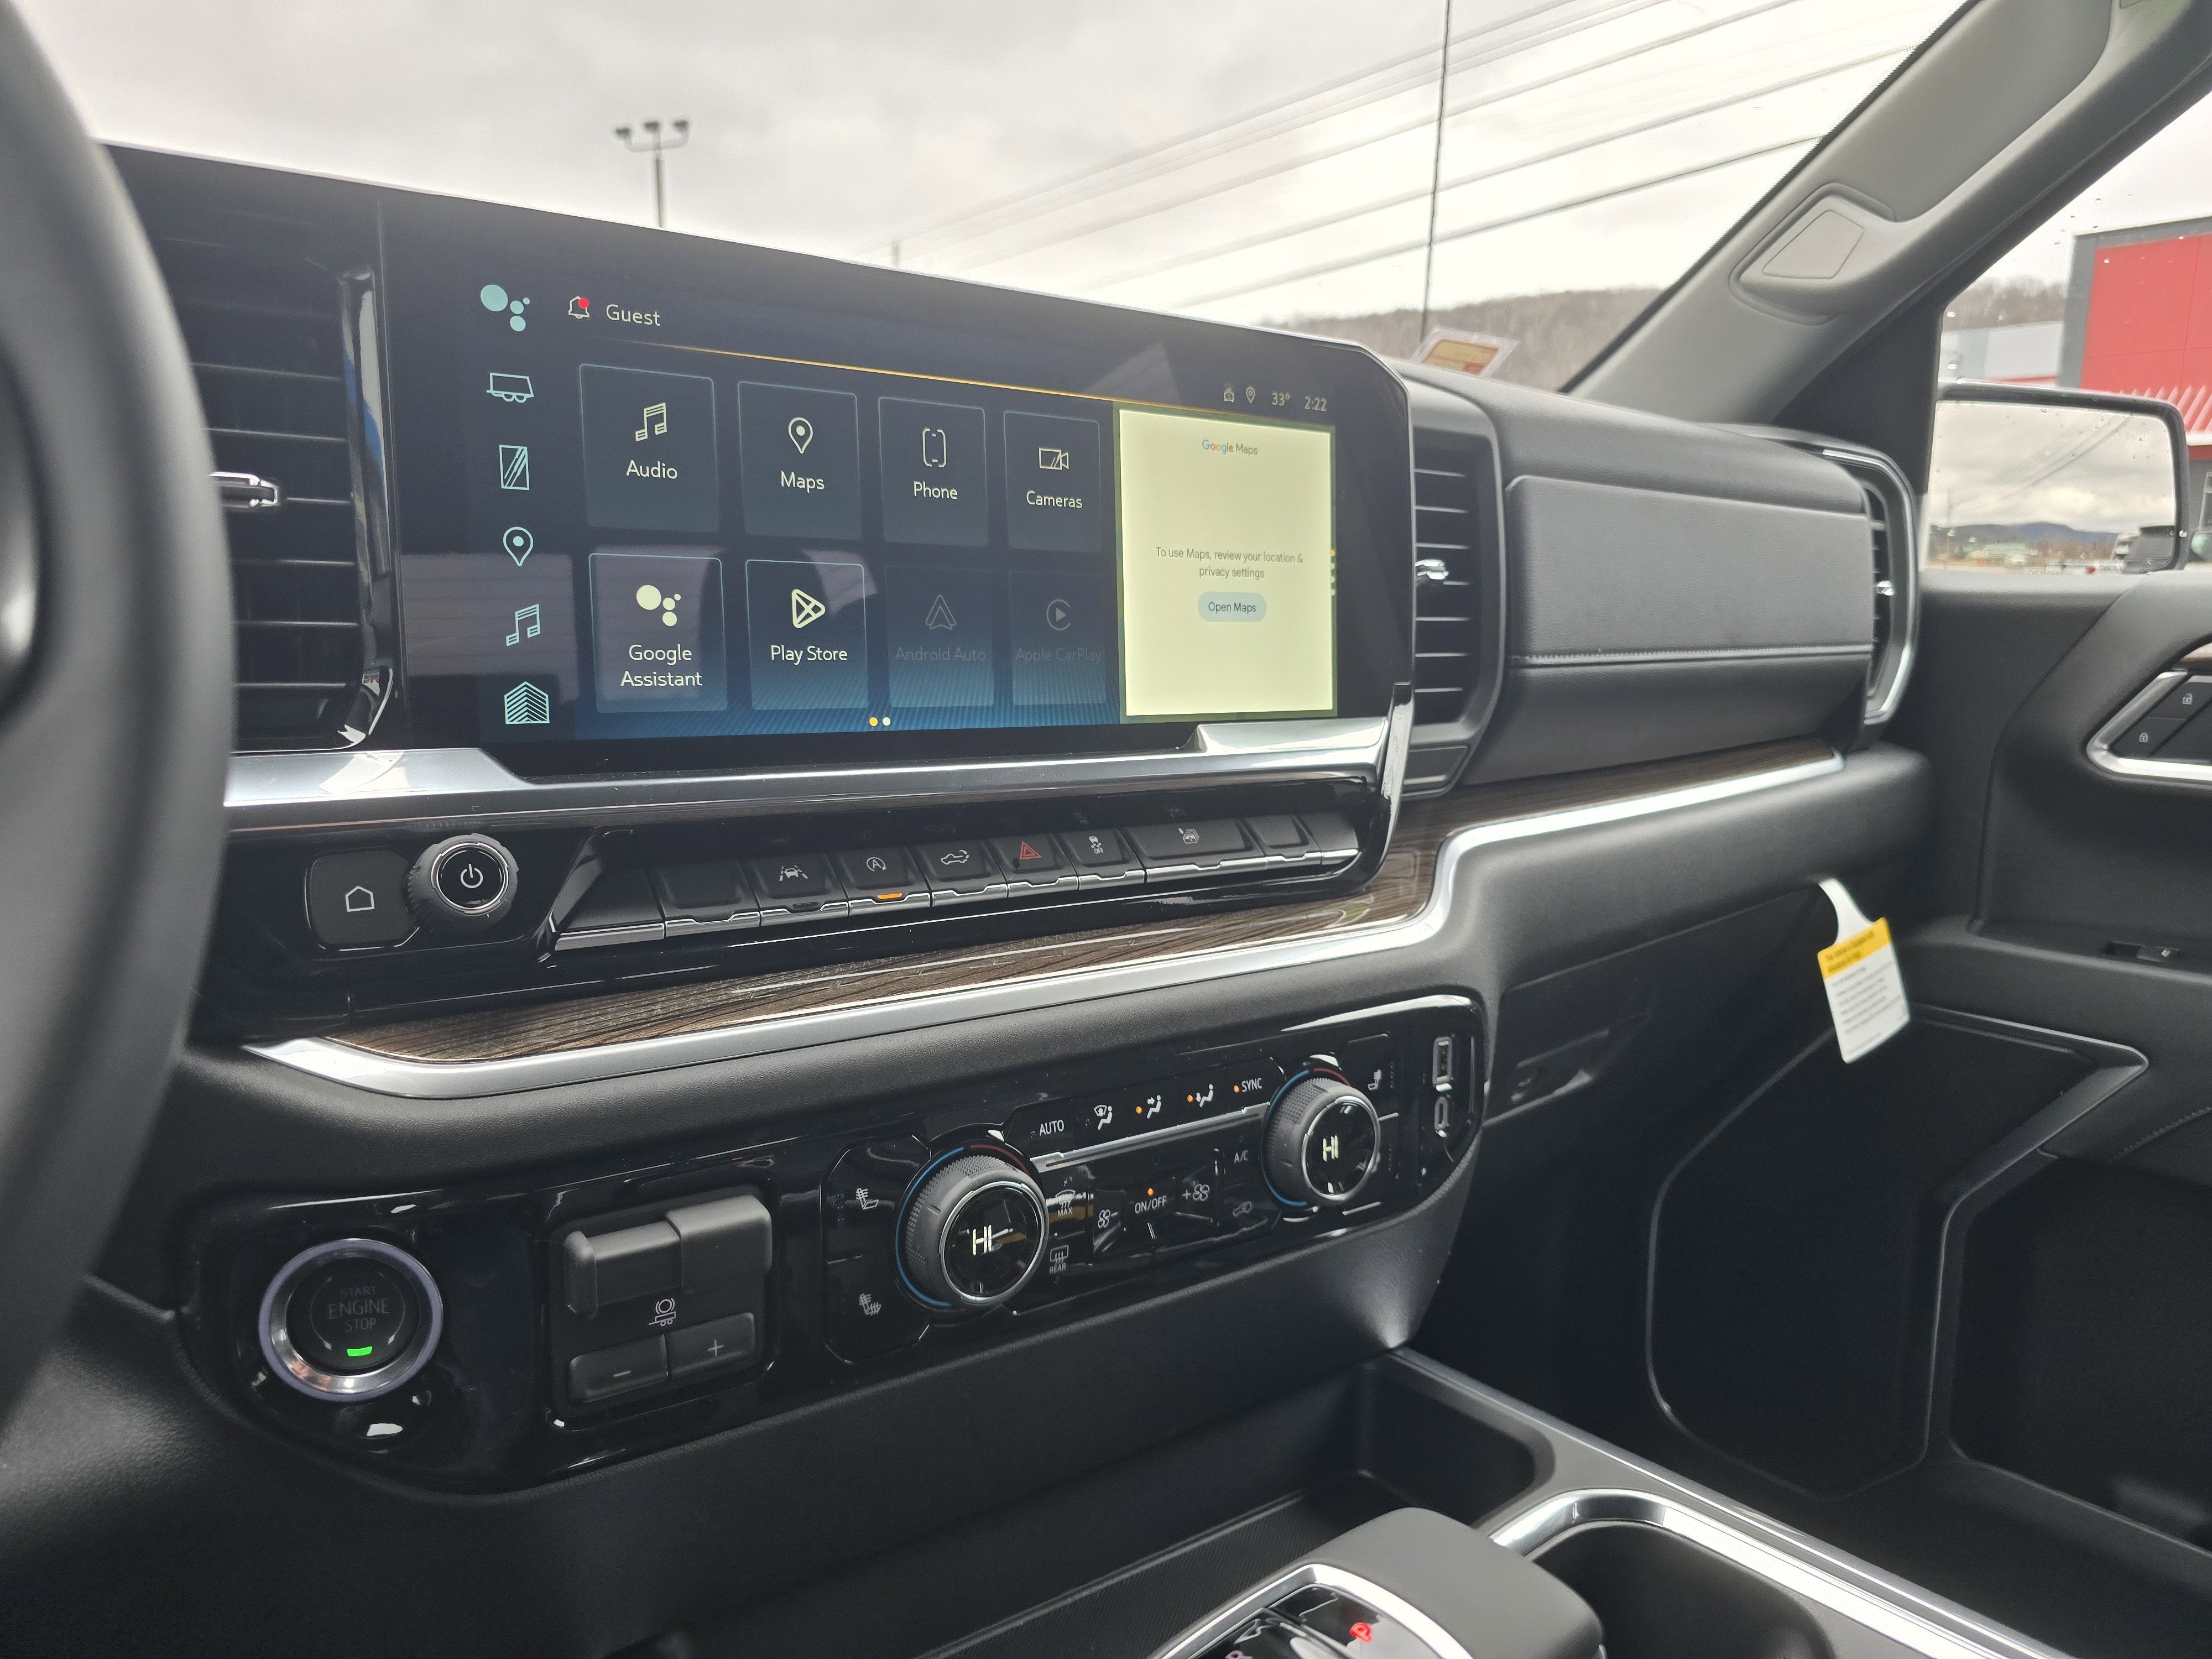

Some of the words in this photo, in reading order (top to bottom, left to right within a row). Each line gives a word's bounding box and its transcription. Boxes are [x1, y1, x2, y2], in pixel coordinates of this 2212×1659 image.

[606, 304, 661, 326] Guest
[1304, 395, 1327, 411] 2:22
[1202, 439, 1234, 455] Google
[1235, 442, 1258, 457] Maps
[625, 460, 678, 479] Audio
[780, 470, 825, 493] Maps
[913, 481, 958, 500] Phone
[1026, 490, 1083, 509] Cameras
[1156, 546, 1166, 557] To
[1168, 549, 1184, 558] use
[1186, 548, 1212, 561] Maps,
[1214, 550, 1241, 561] review
[1243, 552, 1261, 564] your
[1263, 551, 1295, 563] location
[1297, 554, 1303, 564] &
[1199, 565, 1229, 580] privacy
[1232, 567, 1265, 581] settings
[1208, 602, 1232, 614] Open
[1234, 602, 1256, 615] Maps
[628, 644, 692, 666] Google
[770, 645, 804, 666] Play
[807, 645, 848, 662] Store
[895, 646, 950, 661] Android
[953, 646, 986, 661] Auto
[1015, 647, 1052, 665] Apple
[1056, 648, 1102, 665] CarPlay
[620, 670, 703, 687] Assistant
[1241, 1077, 1262, 1093] SYNC
[1039, 1119, 1065, 1136] AUTO
[1233, 1149, 1249, 1164] A/C
[1057, 1207, 1073, 1218] MAX
[1134, 1195, 1167, 1214] ON/OFF
[1049, 1262, 1067, 1274] REAR
[340, 1286, 377, 1299] START
[328, 1298, 390, 1319] ENGINE
[345, 1317, 377, 1332] STOP
[1349, 1621, 1373, 1642] P
